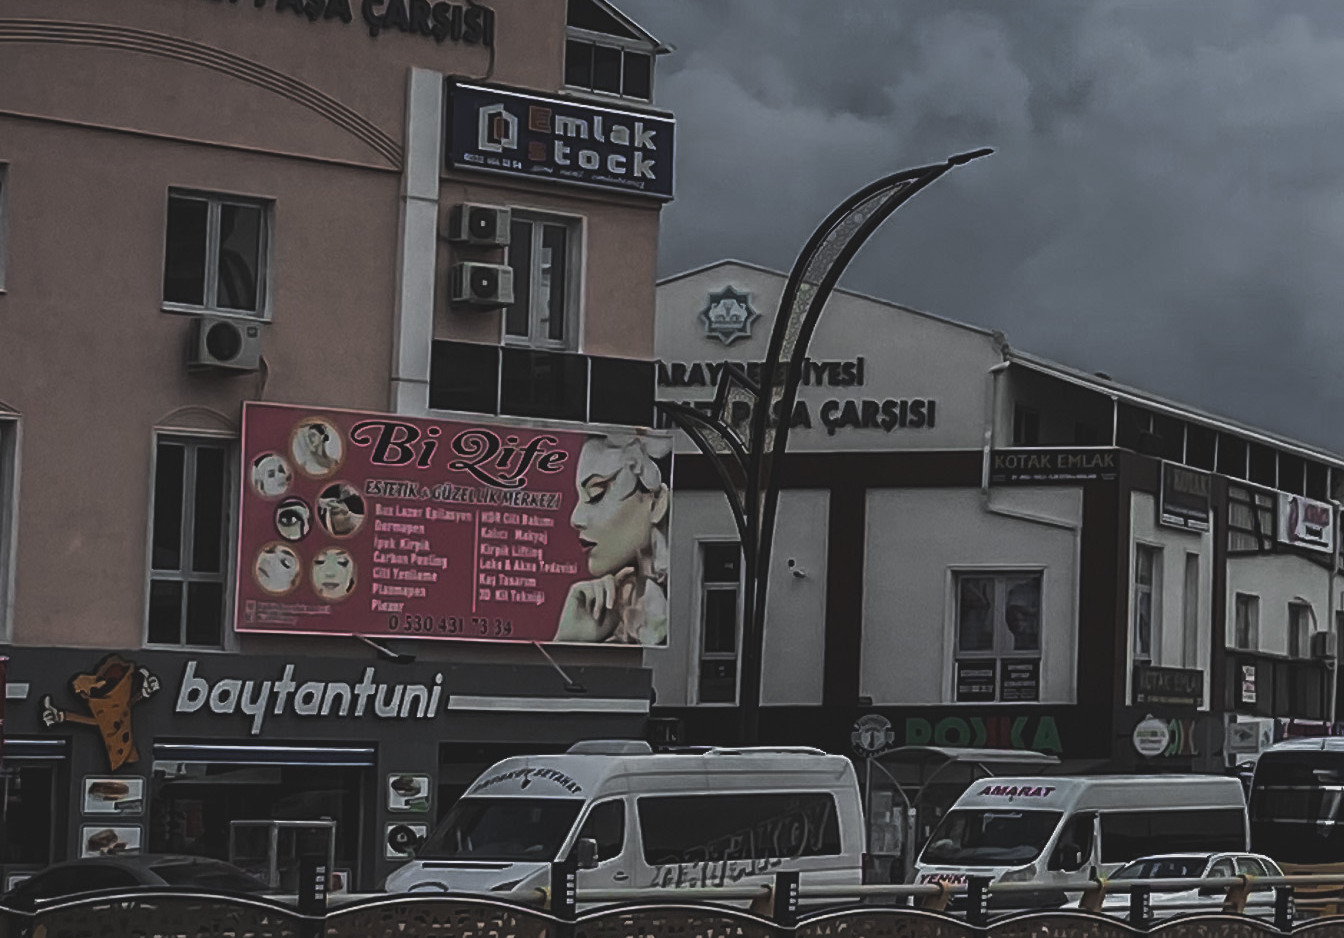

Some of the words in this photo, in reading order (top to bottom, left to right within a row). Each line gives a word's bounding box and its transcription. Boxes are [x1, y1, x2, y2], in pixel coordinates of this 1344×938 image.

[528, 105, 657, 150] Emlak
[820, 400, 937, 436] ÇARŞISI
[350, 420, 442, 469] Bi
[994, 453, 1052, 469] KOTAK
[1057, 452, 1115, 469] EMLAK
[404, 615, 434, 633] 530
[176, 661, 443, 735] baytantuni
[978, 785, 1056, 797] AMARAT
